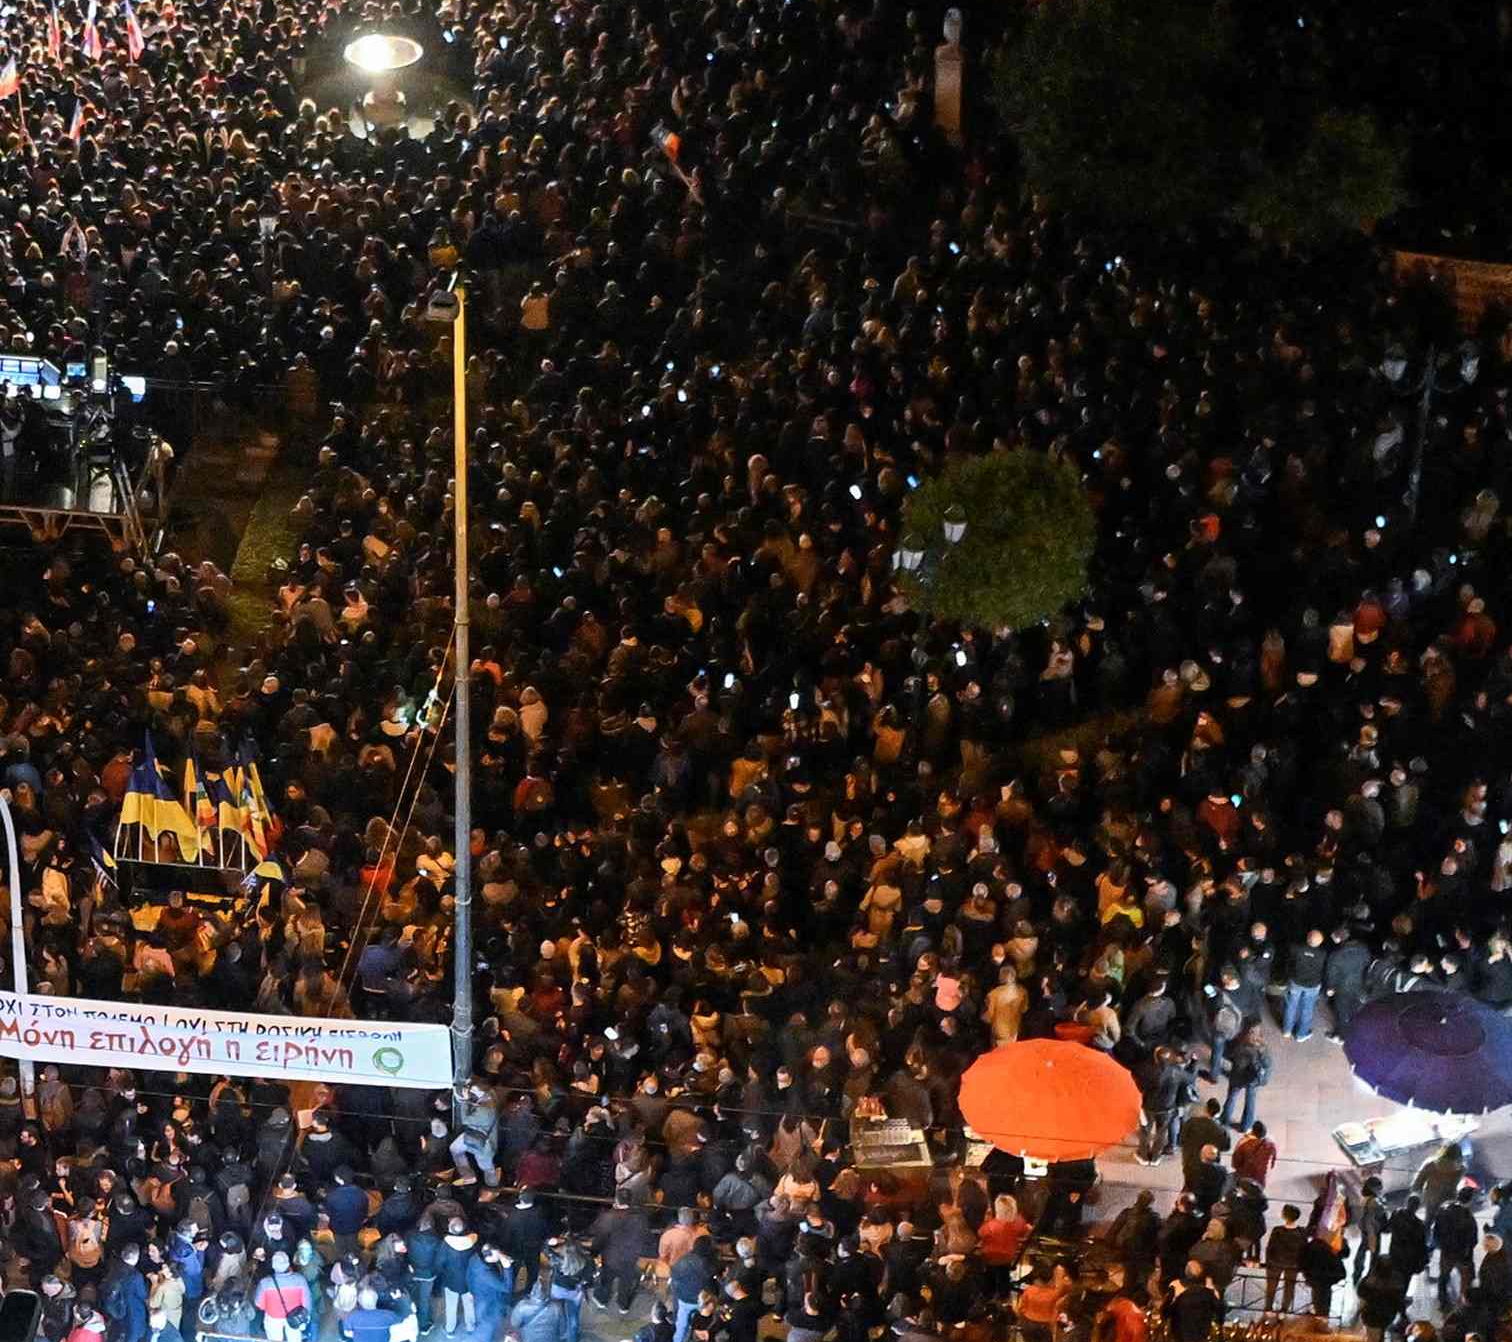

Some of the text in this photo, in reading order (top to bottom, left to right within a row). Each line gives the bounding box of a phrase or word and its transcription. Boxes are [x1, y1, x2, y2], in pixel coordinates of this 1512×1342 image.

[89, 1025, 211, 1066] επιλογή
[225, 1039, 241, 1060] η
[255, 1038, 353, 1069] ειρήνη
